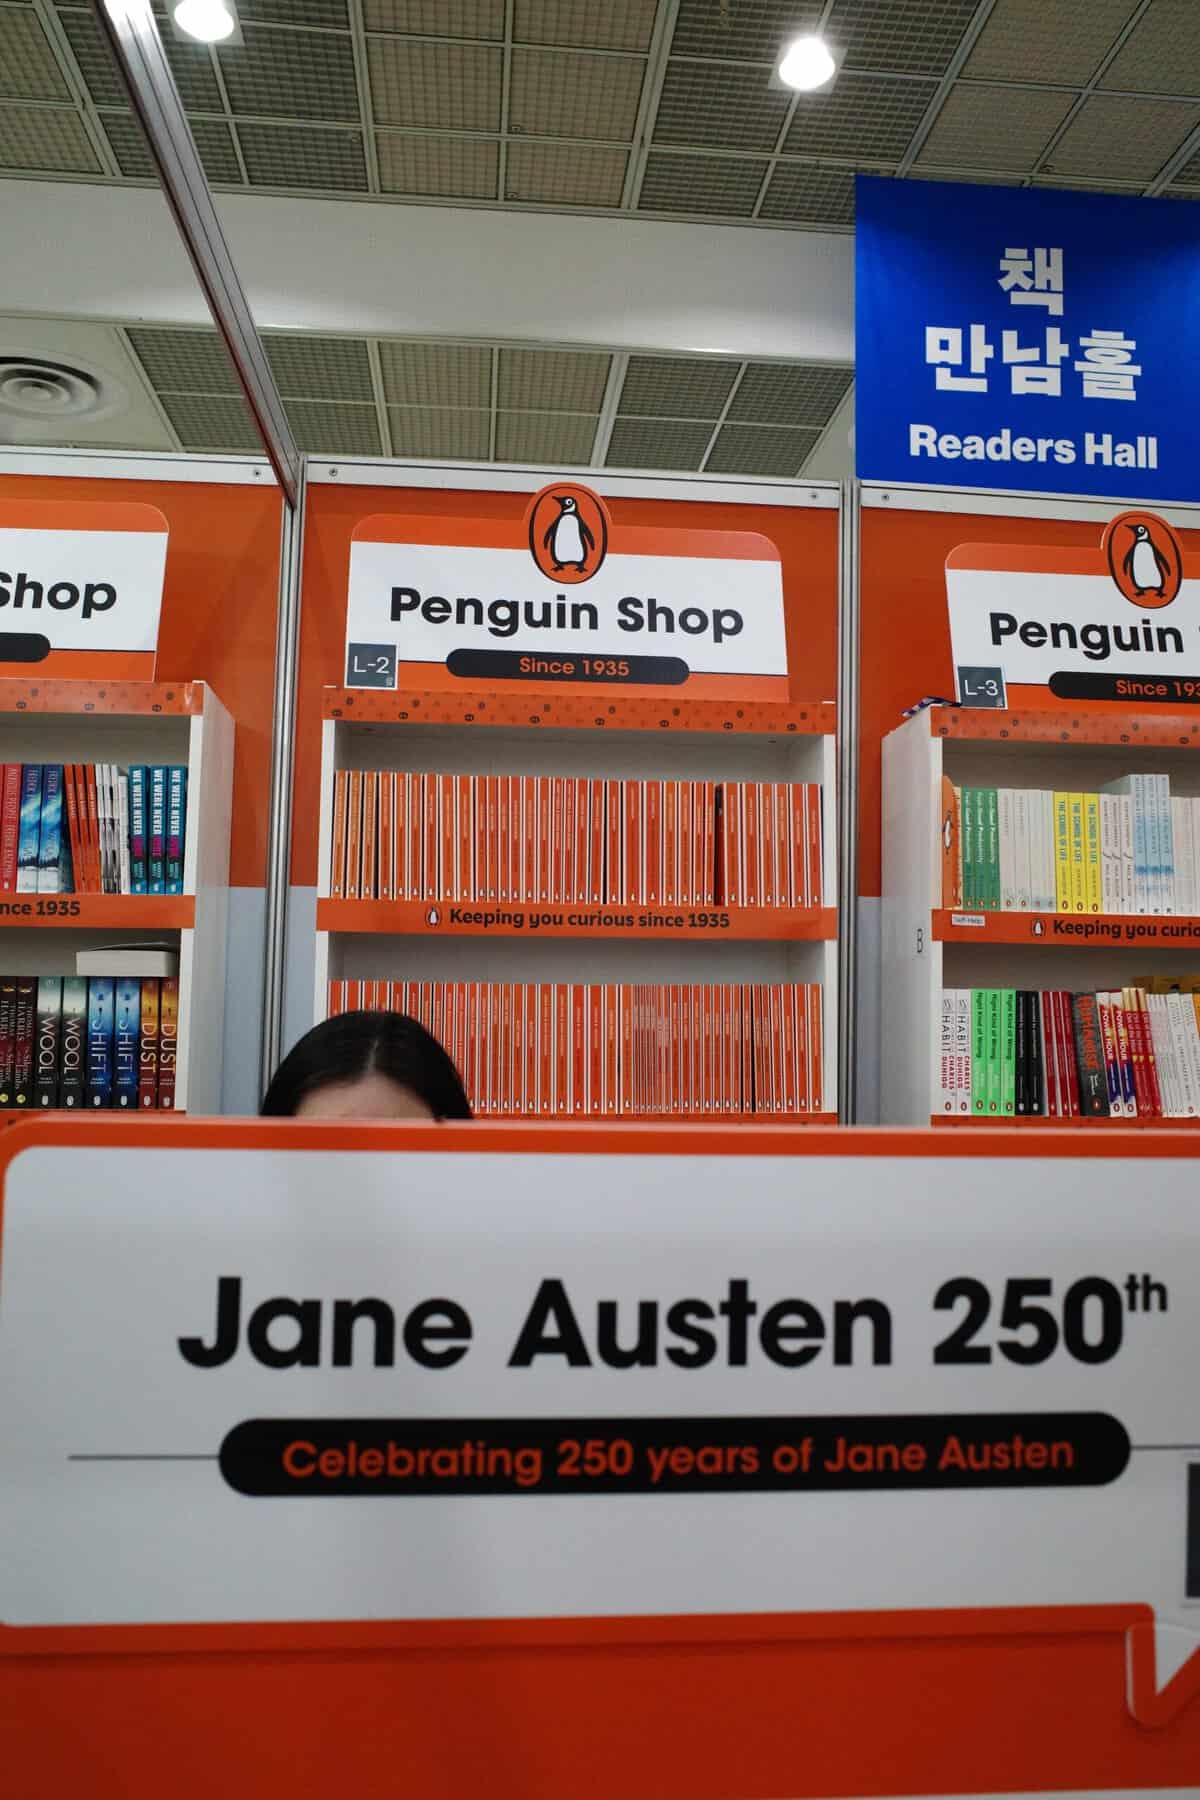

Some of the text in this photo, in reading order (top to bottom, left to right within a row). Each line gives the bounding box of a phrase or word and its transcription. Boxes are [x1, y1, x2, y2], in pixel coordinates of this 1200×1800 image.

[998, 248, 1064, 316] 책
[925, 324, 1142, 401] 만남홀
[909, 423, 1158, 469] Readers Hall
[390, 586, 744, 643] Penguin Shop
[990, 612, 1184, 660] Penguin
[353, 655, 390, 674] L-2
[520, 657, 630, 677] Since 1935
[964, 679, 999, 696] L-3
[1116, 680, 1168, 696] Since
[133, 770, 142, 782] WE
[153, 770, 163, 782] WE
[172, 770, 181, 782] WE
[133, 785, 142, 807] WERE
[153, 784, 162, 807] WERE
[172, 785, 180, 807] WERE
[133, 810, 142, 835] NEVER
[153, 810, 162, 834] NEVER
[171, 810, 180, 835] NEVER
[36, 900, 81, 916] 1935
[450, 908, 730, 929] Keeping you curious since 1935
[1053, 919, 1121, 938] Keeping
[1125, 924, 1156, 939] you
[39, 1016, 55, 1073] WOOL
[64, 1017, 80, 1074] WOOL
[117, 1020, 133, 1072] SHIFT
[942, 1015, 950, 1052] HABIT
[958, 1016, 966, 1052] HABIT
[91, 1020, 107, 1073] SHIFT
[140, 1023, 157, 1073] DUST
[161, 1023, 176, 1075] DUST
[1105, 1039, 1113, 1060] HOUR
[1119, 1039, 1127, 1060] HOUR
[178, 1273, 1169, 1369] Jane Austen 250th
[283, 1434, 1074, 1487] Celebrating 250 years of Jane Austen
